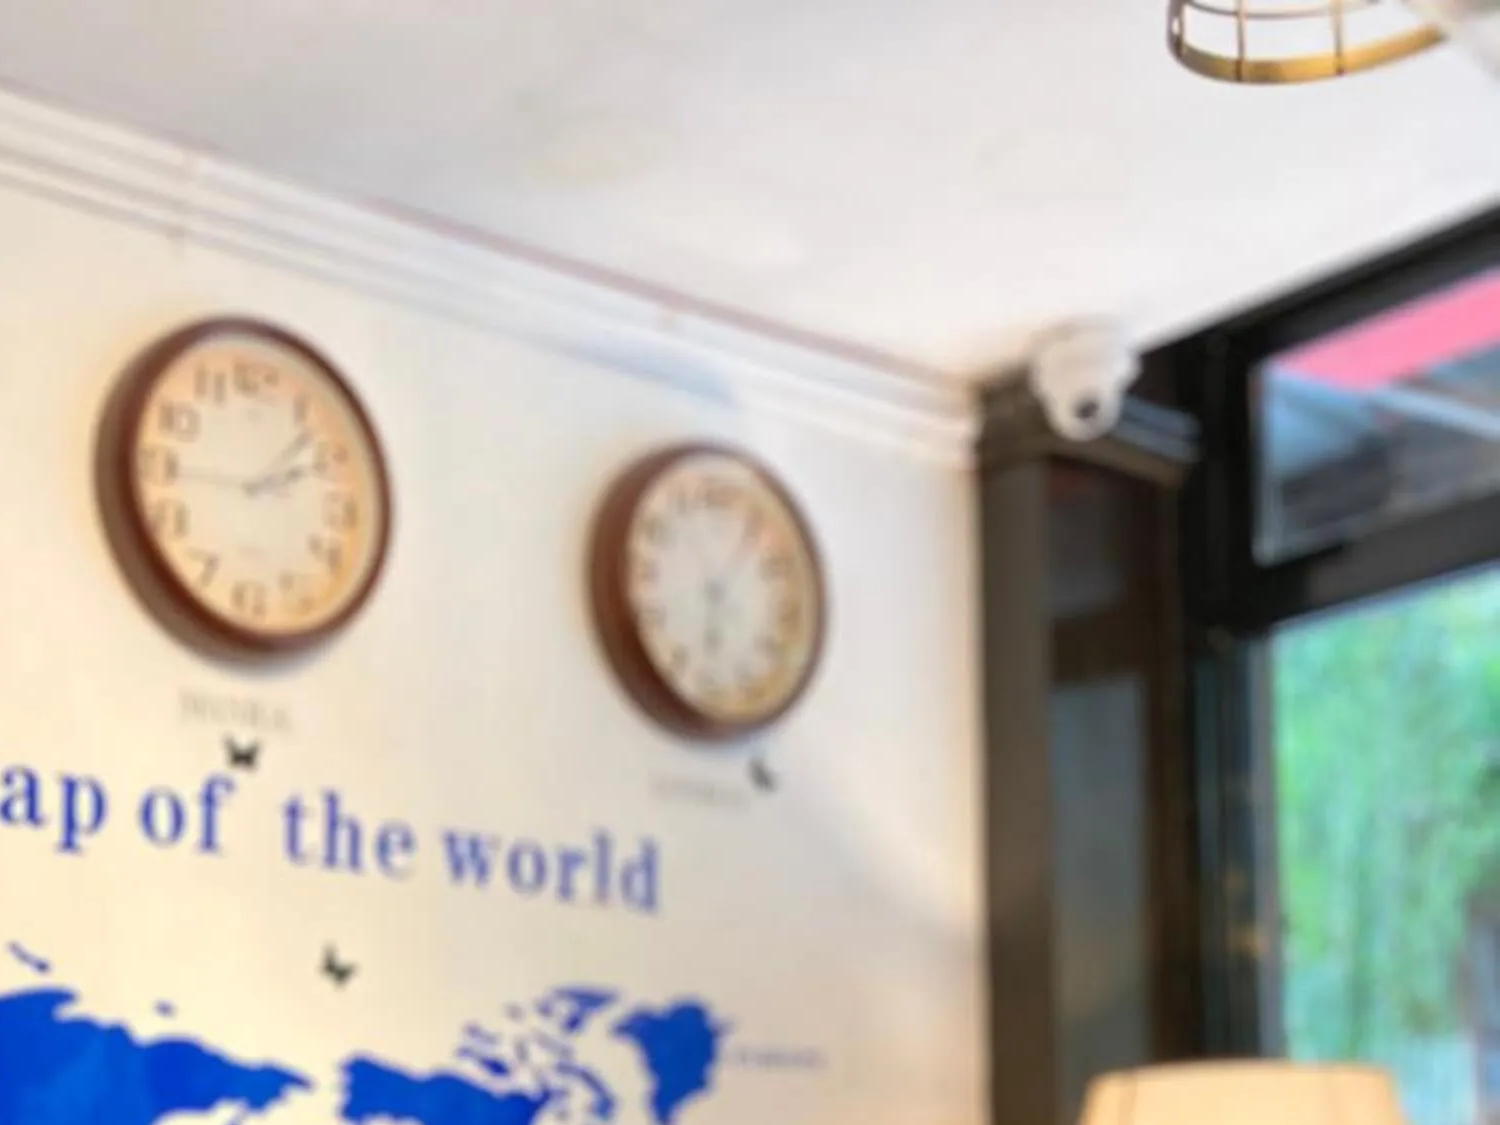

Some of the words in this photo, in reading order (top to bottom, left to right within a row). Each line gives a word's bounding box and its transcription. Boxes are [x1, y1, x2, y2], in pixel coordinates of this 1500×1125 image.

[138, 772, 236, 854] of
[282, 791, 418, 879] the
[442, 827, 662, 914] world
